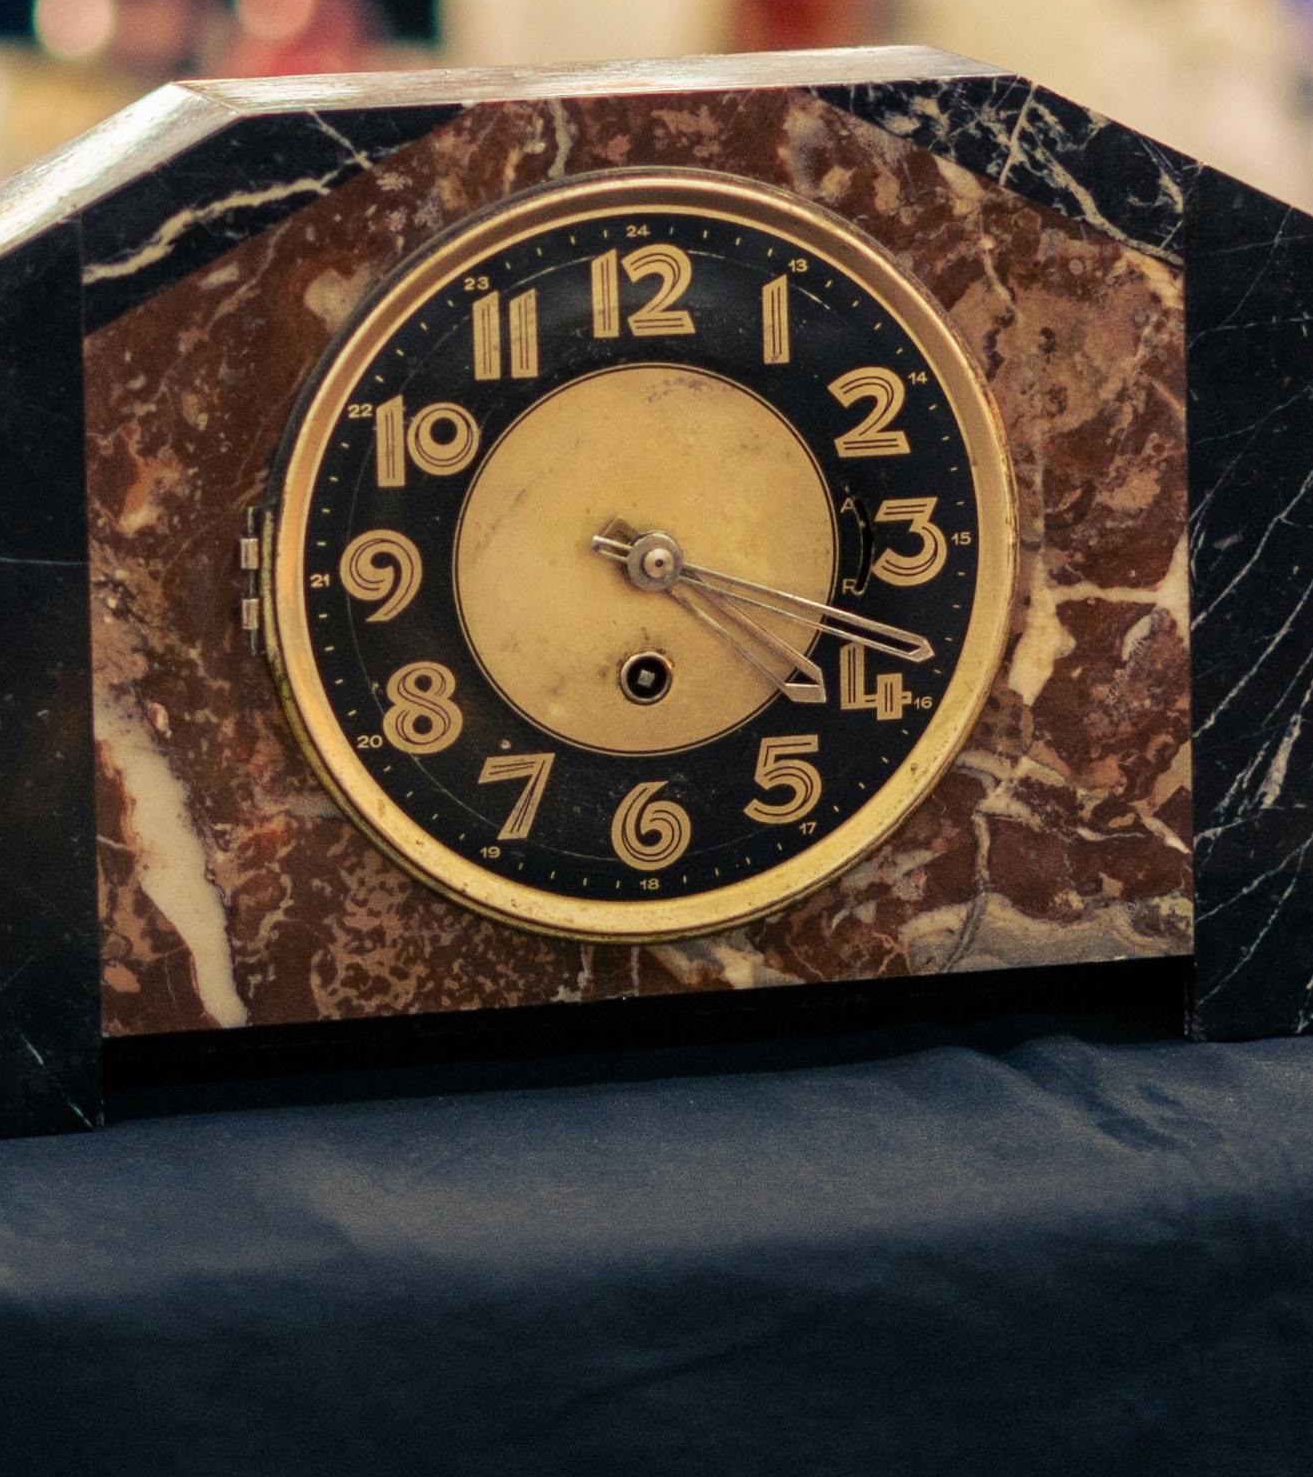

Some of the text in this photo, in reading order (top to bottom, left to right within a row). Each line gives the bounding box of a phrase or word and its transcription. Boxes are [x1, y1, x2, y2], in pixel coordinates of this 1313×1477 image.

[626, 224, 651, 238] 24
[464, 276, 490, 291] 23
[788, 258, 808, 273] 13
[590, 243, 696, 339] 12
[472, 288, 539, 381] 11
[761, 274, 790, 365] 1
[907, 371, 928, 385] 14
[347, 403, 373, 419] 22
[827, 366, 911, 458] 2
[375, 394, 480, 488] 10
[872, 496, 948, 587] 3
[951, 531, 972, 545] 15
[310, 573, 330, 588] 21
[339, 528, 423, 622] 9
[839, 640, 913, 722] 4
[913, 696, 933, 710] 16
[382, 660, 464, 755] 8
[356, 734, 383, 749] 20
[477, 752, 556, 841] 7
[743, 734, 822, 825] 5
[610, 780, 692, 871] 6
[799, 821, 817, 835] 17
[480, 845, 501, 859] 19
[639, 877, 660, 890] 18
